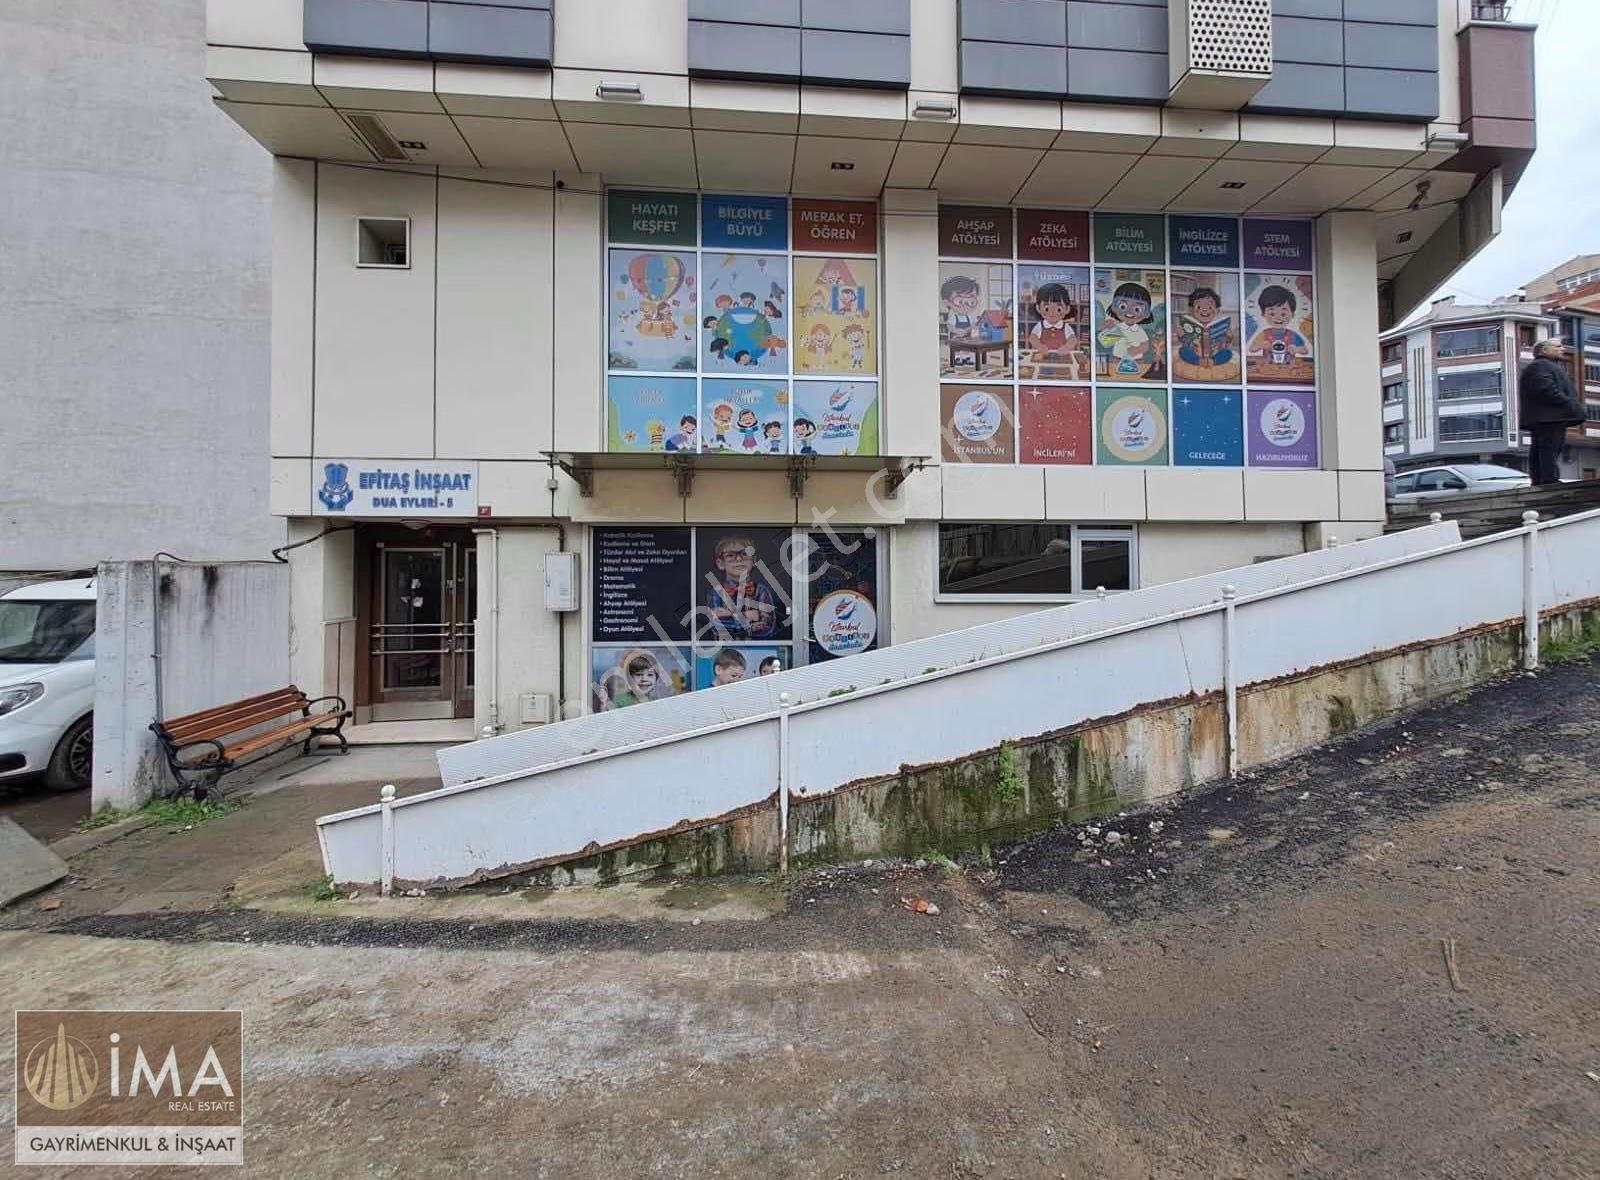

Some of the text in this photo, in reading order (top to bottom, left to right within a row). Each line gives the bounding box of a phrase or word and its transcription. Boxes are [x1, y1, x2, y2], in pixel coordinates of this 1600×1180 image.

[631, 203, 678, 216] HAYATI
[718, 205, 773, 220] BİLGİYLE
[800, 210, 845, 224] MERAK
[632, 219, 677, 234] KEŞFET
[727, 221, 763, 236] BÜYÜ
[810, 224, 856, 240] ÖĞREN
[956, 219, 994, 233] AHŞAP
[1040, 222, 1067, 234] ZEKA
[1115, 226, 1145, 239] BİLİM
[951, 232, 1000, 246] ATÖLYESİ
[1179, 228, 1228, 242] İNGİLİZCE
[1263, 233, 1290, 244] STEM
[1029, 236, 1078, 249] ATÖLYESİ
[1105, 239, 1153, 253] ATÖLYESİ
[1180, 242, 1227, 255] ATÖLYESİ
[1254, 244, 1300, 258] ATÖLYESİ
[359, 468, 472, 494] EFİTAŞ İNŞAAT
[372, 497, 398, 509] DUA
